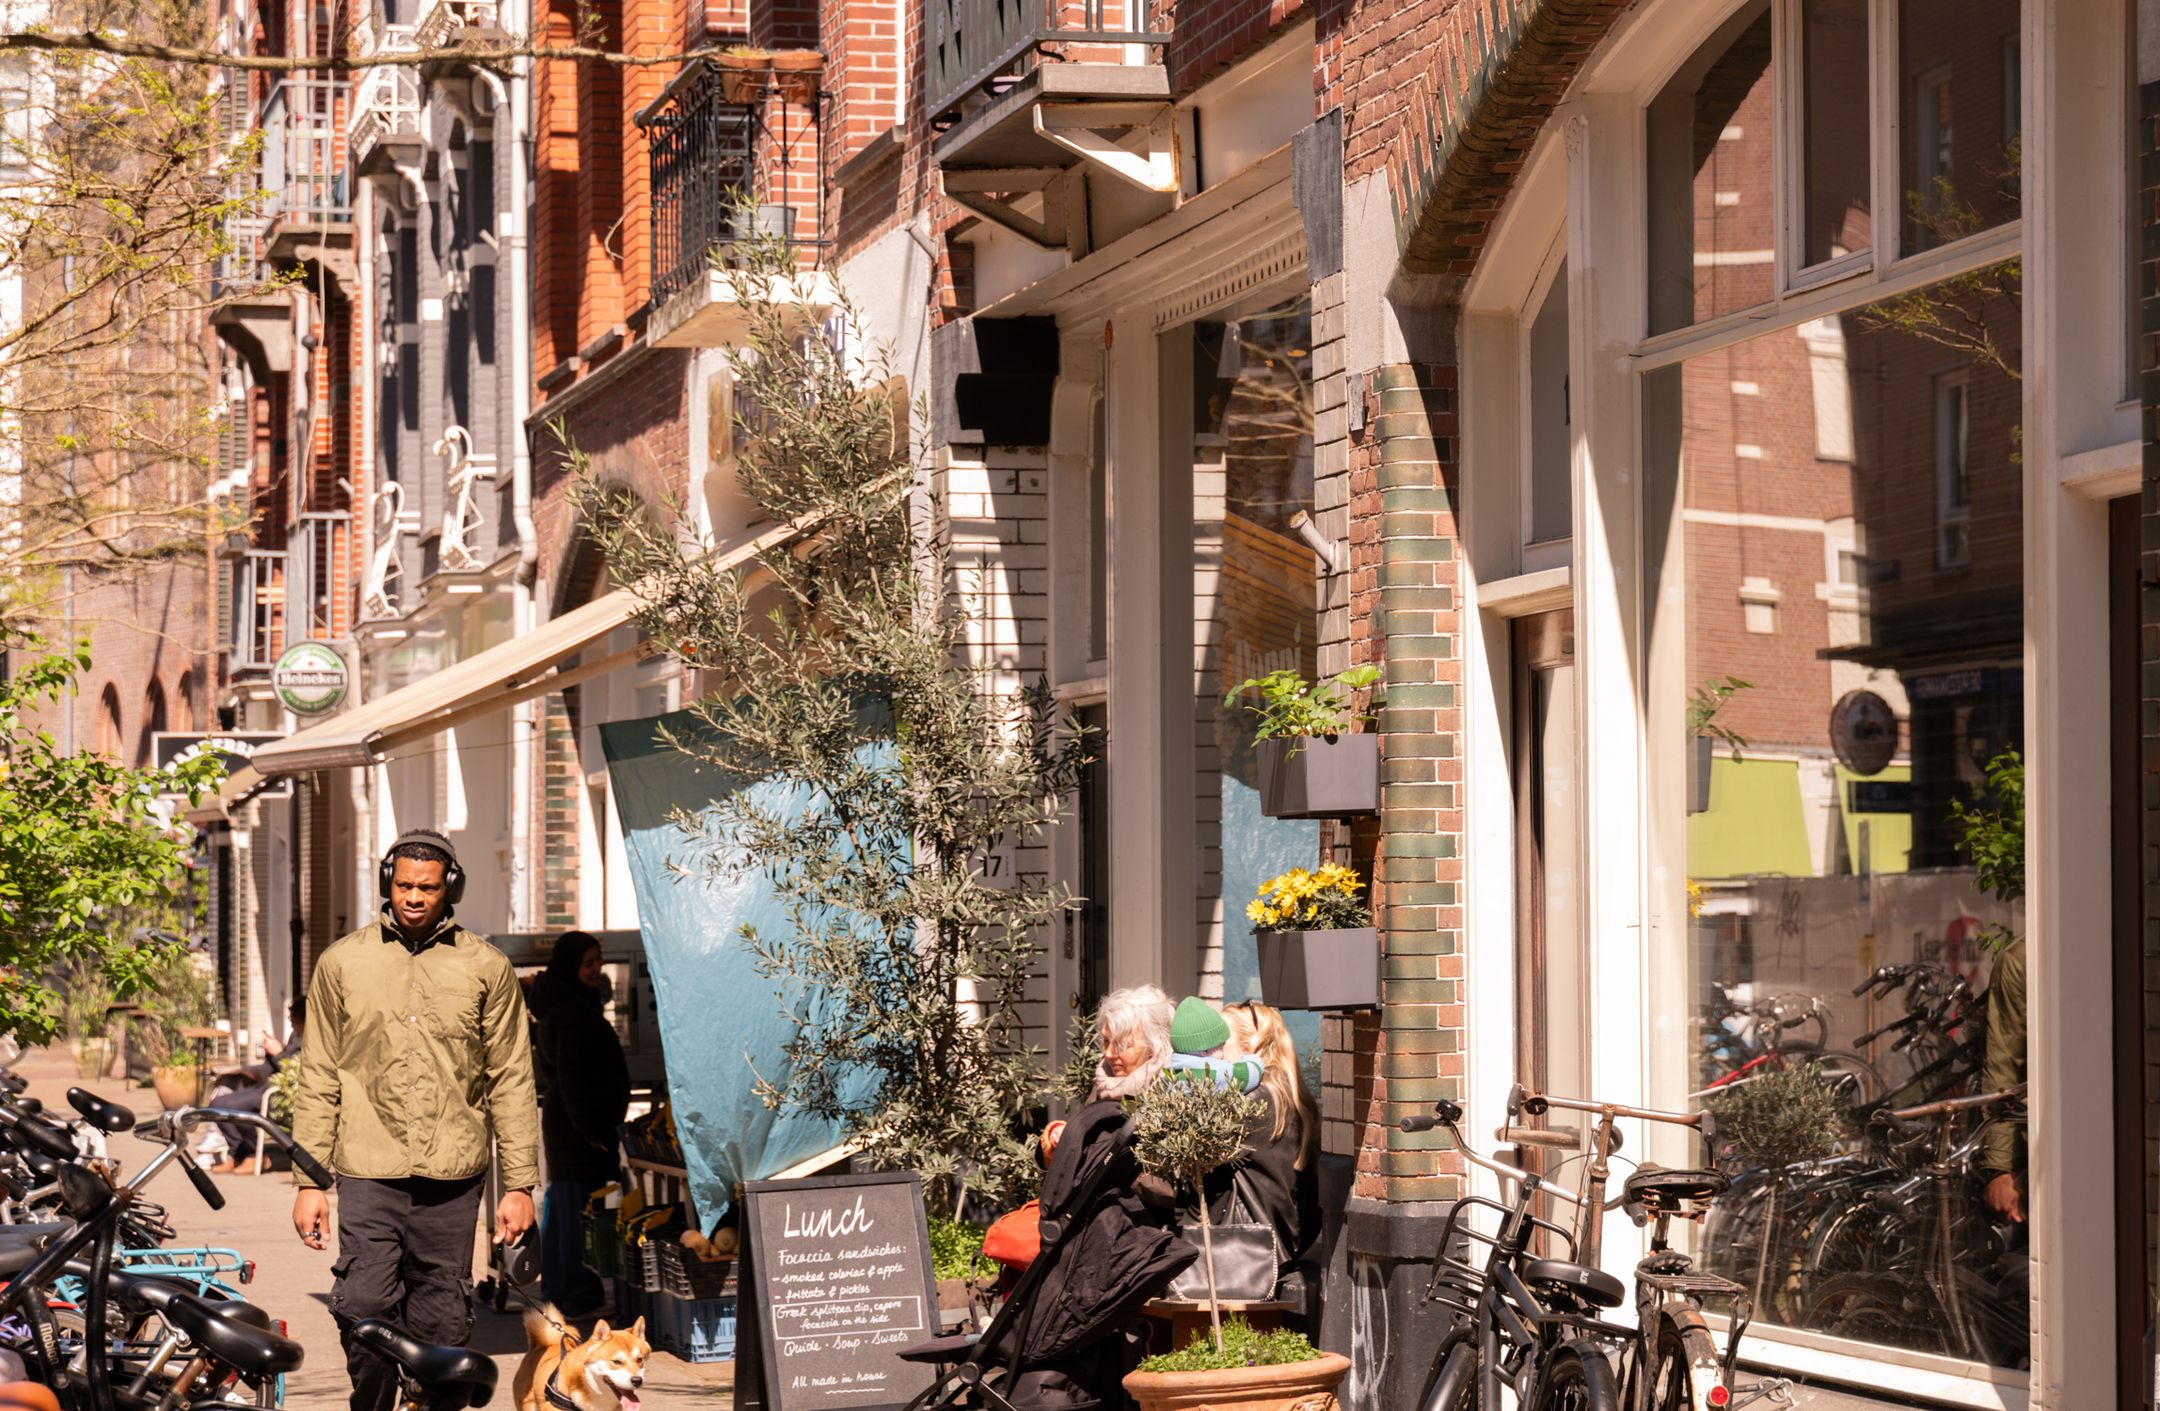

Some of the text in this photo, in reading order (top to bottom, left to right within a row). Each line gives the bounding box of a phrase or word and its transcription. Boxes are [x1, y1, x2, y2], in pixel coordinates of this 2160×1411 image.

[281, 673, 341, 686] Heineken
[979, 856, 1002, 877] 17
[783, 1194, 874, 1238] Lunch
[777, 1242, 906, 1266] Focaccia sandwiches:
[828, 1268, 866, 1280] celeriac
[877, 1263, 905, 1281] apple
[839, 1284, 870, 1300] pickles
[869, 1314, 891, 1324] side
[792, 1371, 887, 1389] All made in house
